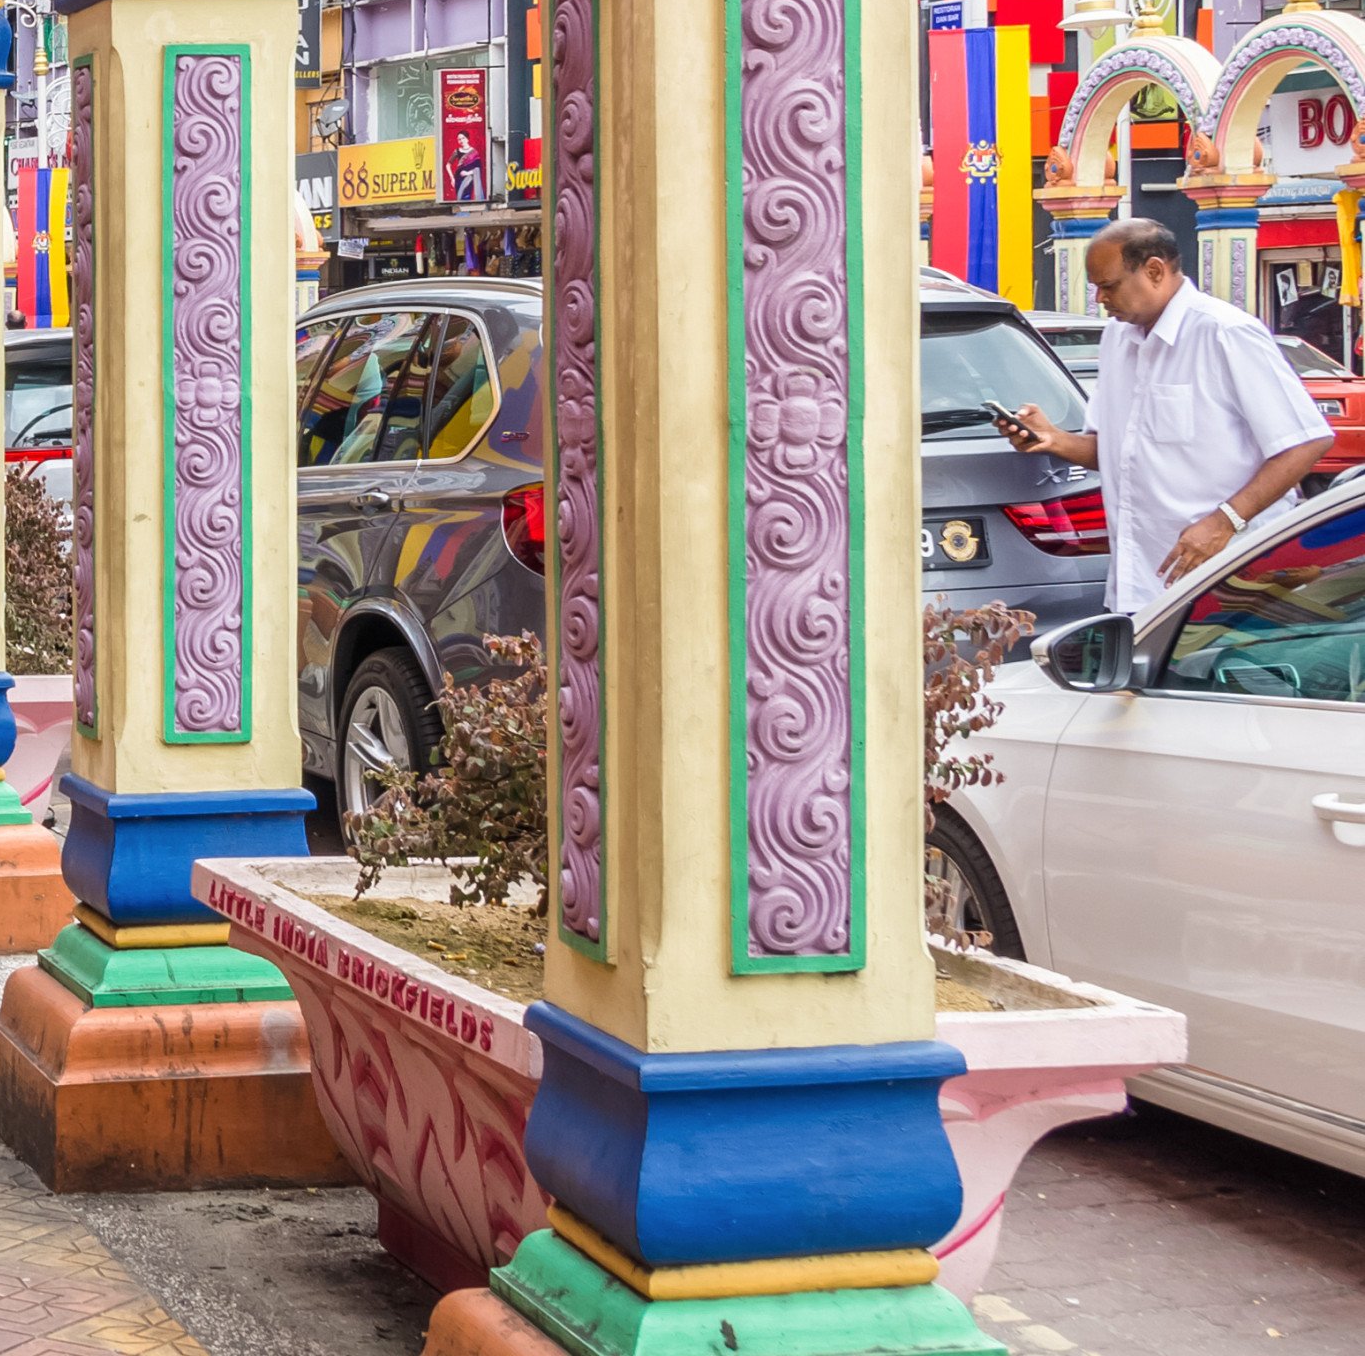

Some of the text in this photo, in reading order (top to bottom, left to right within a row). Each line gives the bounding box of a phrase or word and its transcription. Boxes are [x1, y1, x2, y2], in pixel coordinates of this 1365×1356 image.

[342, 161, 370, 200] 88
[372, 170, 418, 194] SUPER
[208, 879, 495, 1052] LITTLE INDIA BRICKFIELDS
